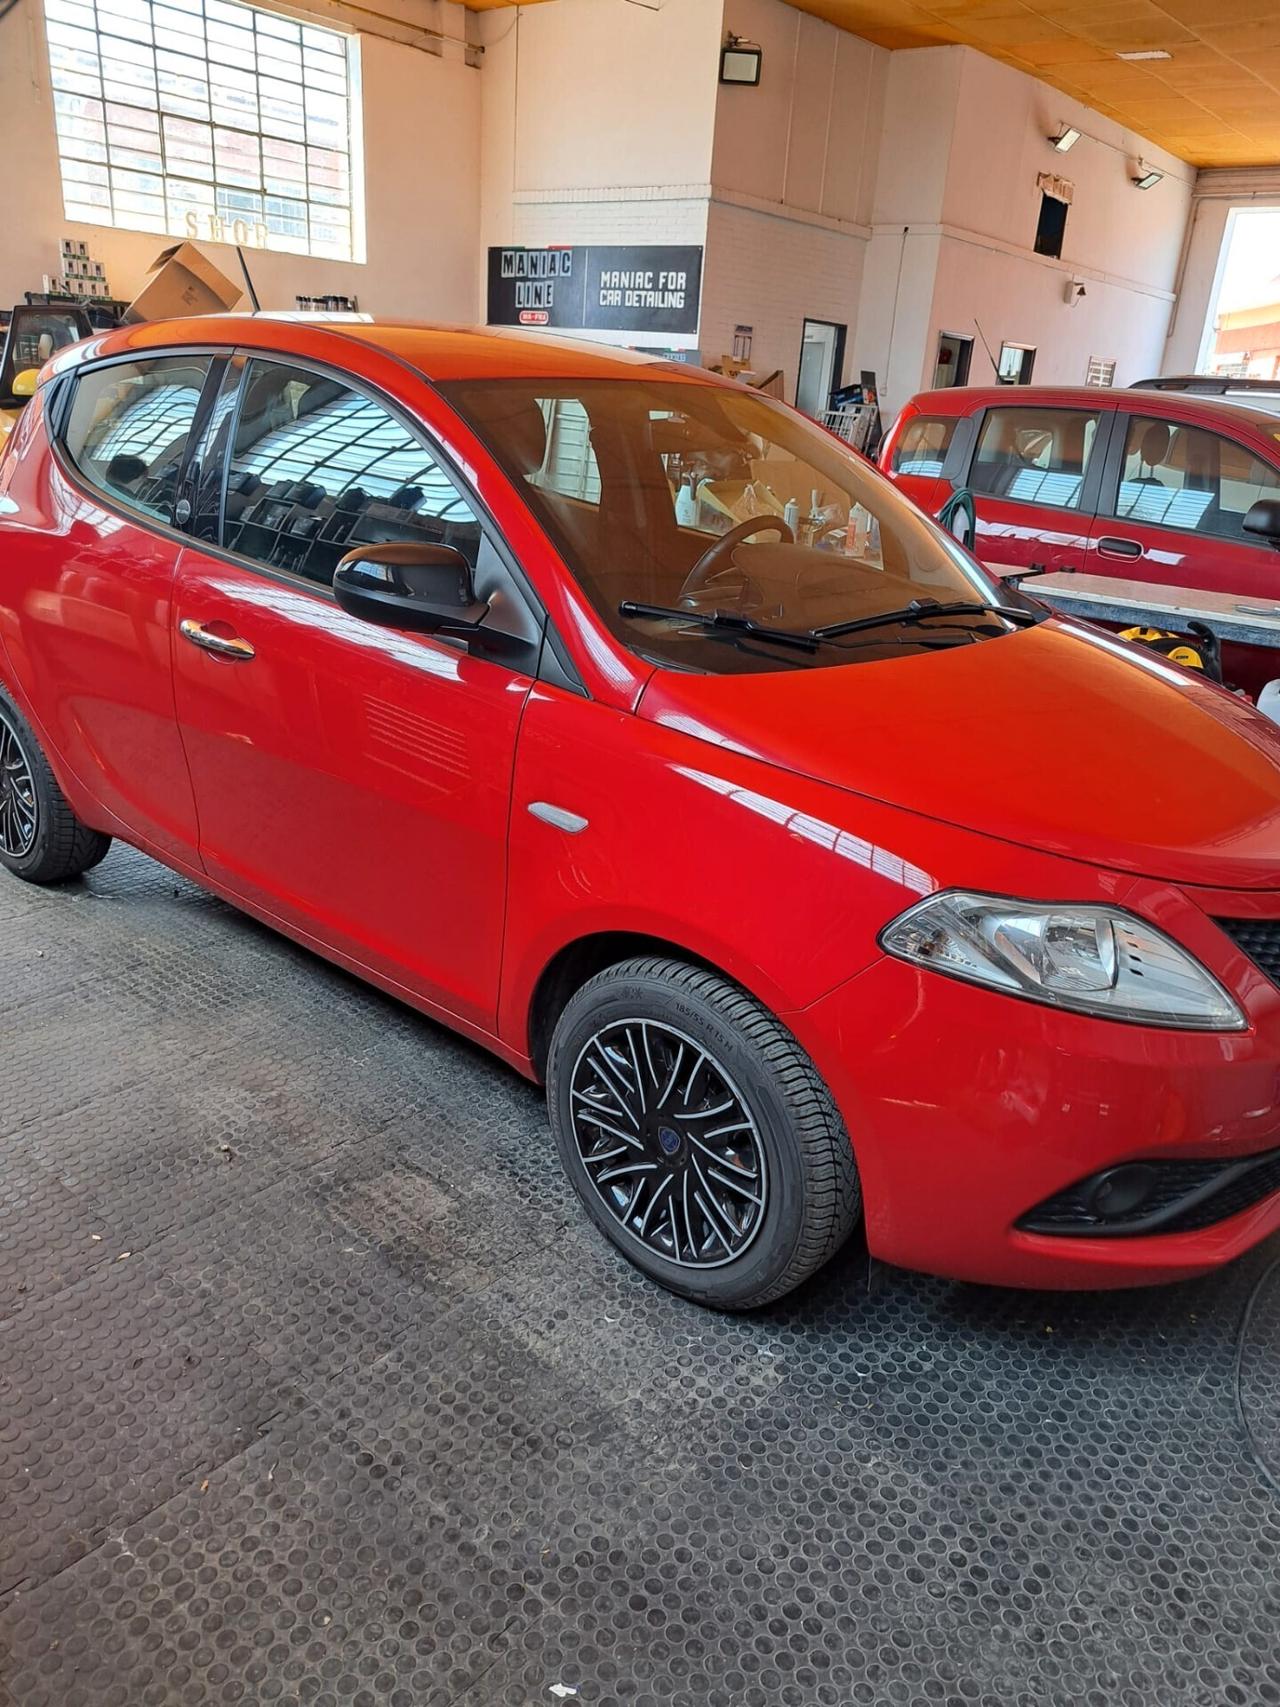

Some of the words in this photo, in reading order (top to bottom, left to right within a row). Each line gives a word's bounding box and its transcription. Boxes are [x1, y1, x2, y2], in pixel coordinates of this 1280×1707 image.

[185, 211, 269, 249] SHOP
[502, 251, 571, 276] MANIAC
[600, 271, 653, 289] MANIAC
[658, 271, 687, 290] FOR
[515, 282, 554, 306] LINE
[599, 289, 621, 306] CAR
[624, 290, 685, 308] DETAILING
[675, 1002, 705, 1026] 185/55
[706, 1023, 714, 1033] R
[715, 1031, 724, 1043] 15
